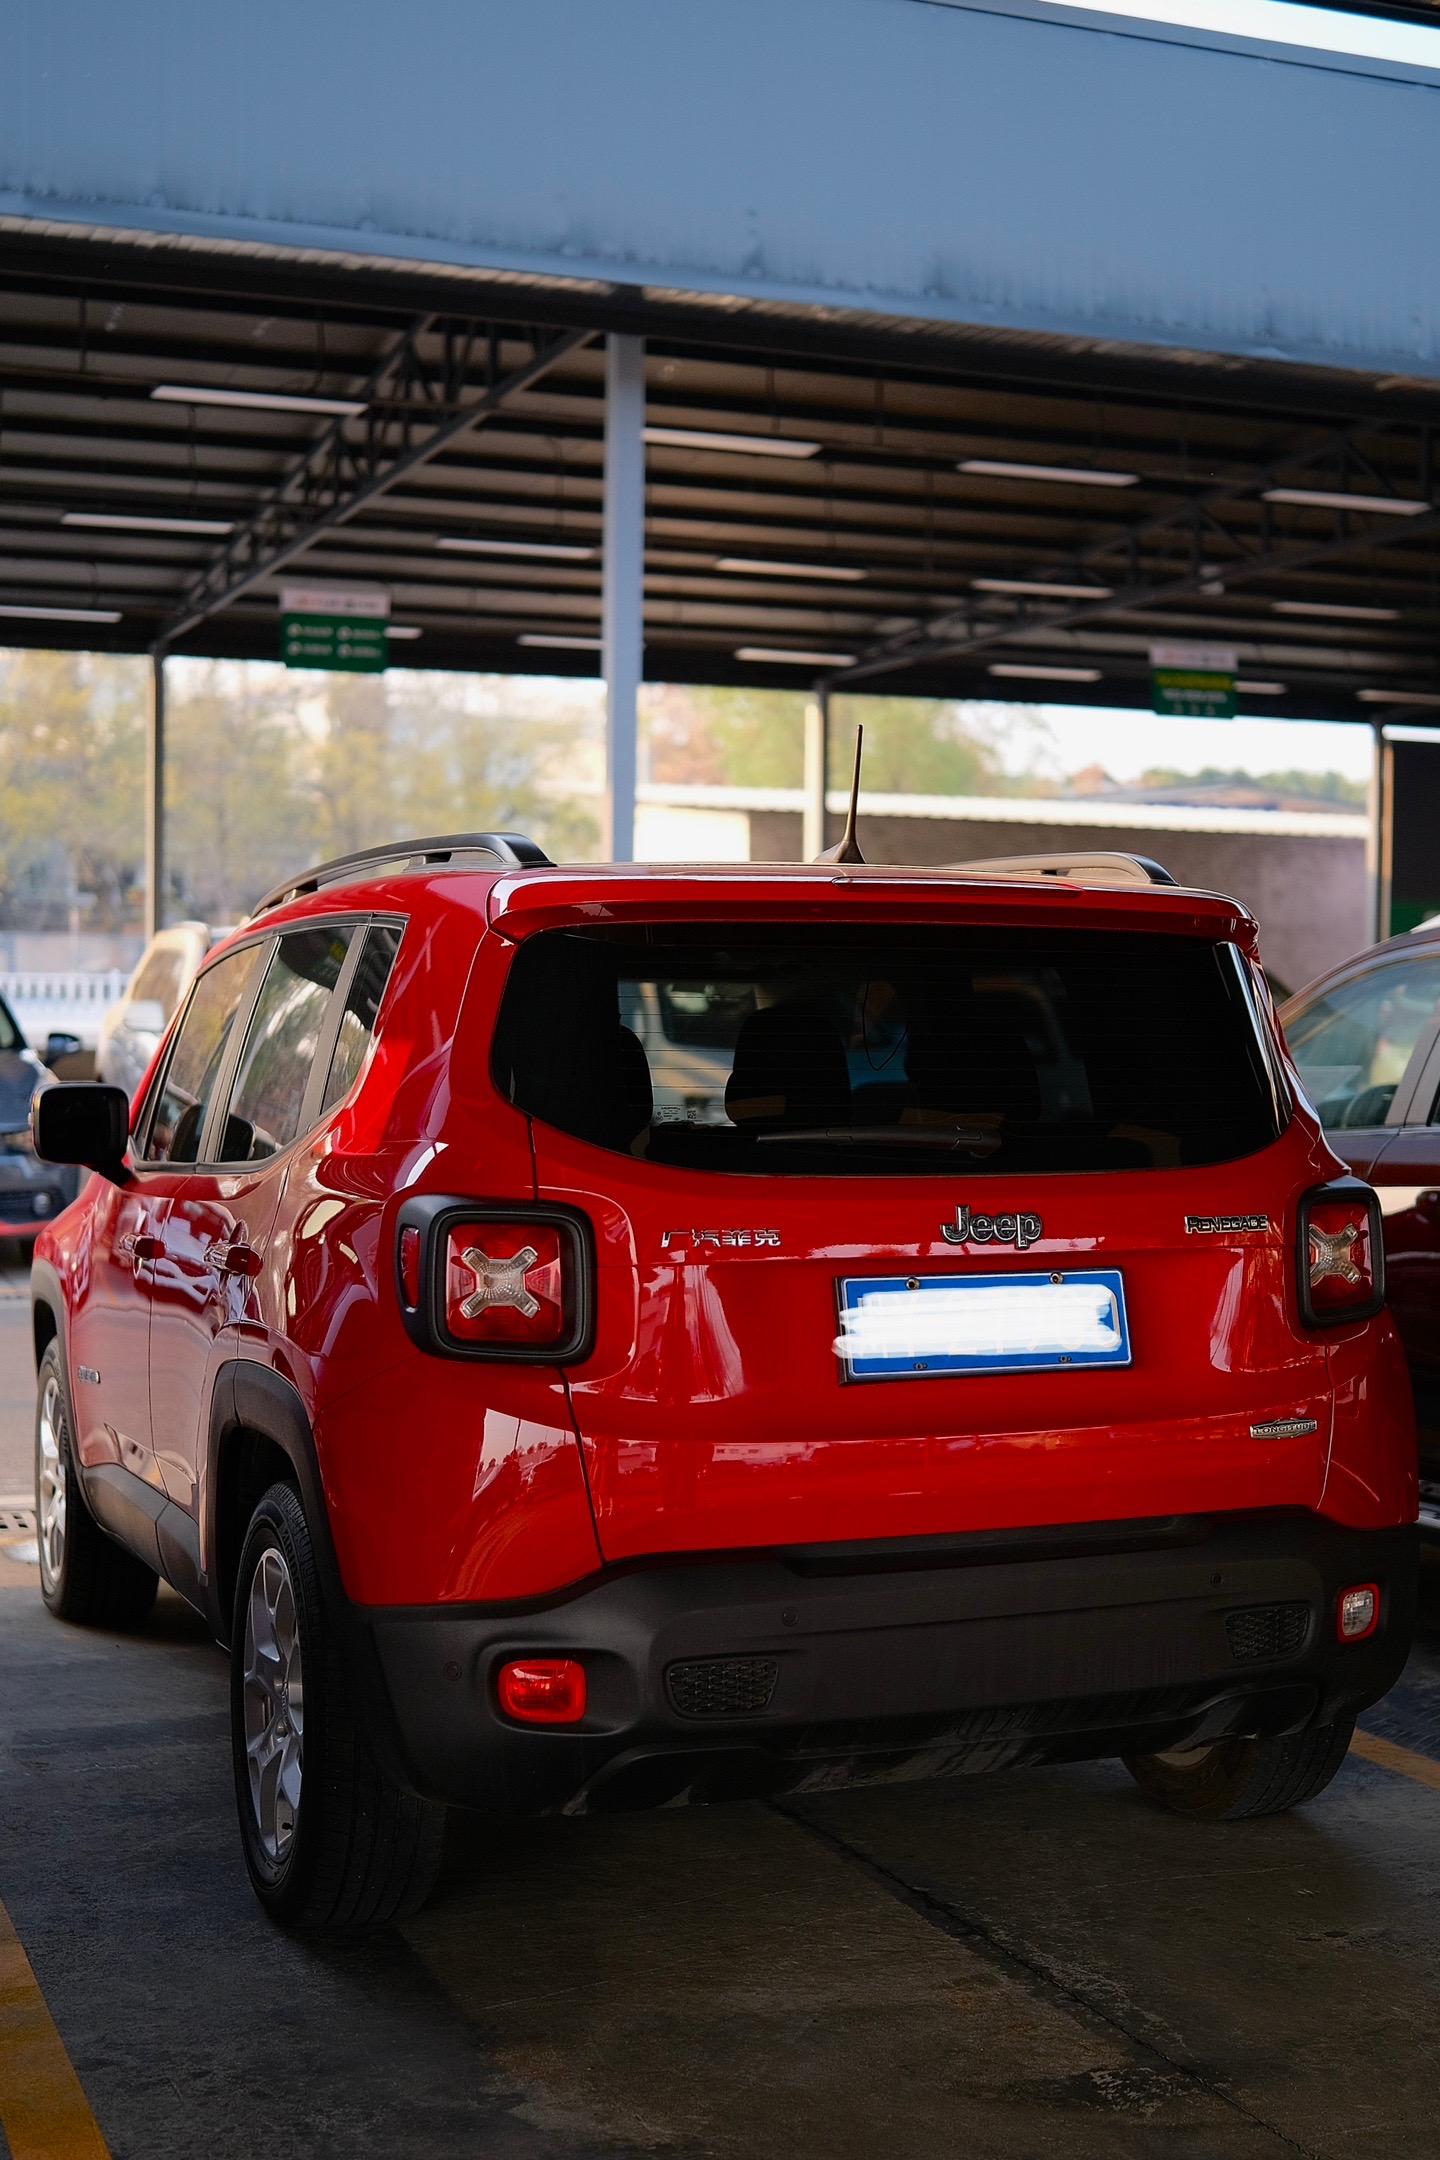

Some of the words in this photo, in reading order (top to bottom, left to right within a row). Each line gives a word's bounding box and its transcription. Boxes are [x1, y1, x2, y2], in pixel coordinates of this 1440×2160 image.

[941, 1205, 1042, 1248] Jeep
[1184, 1214, 1269, 1234] RENEGADE
[661, 1228, 782, 1248] 广汽菲克
